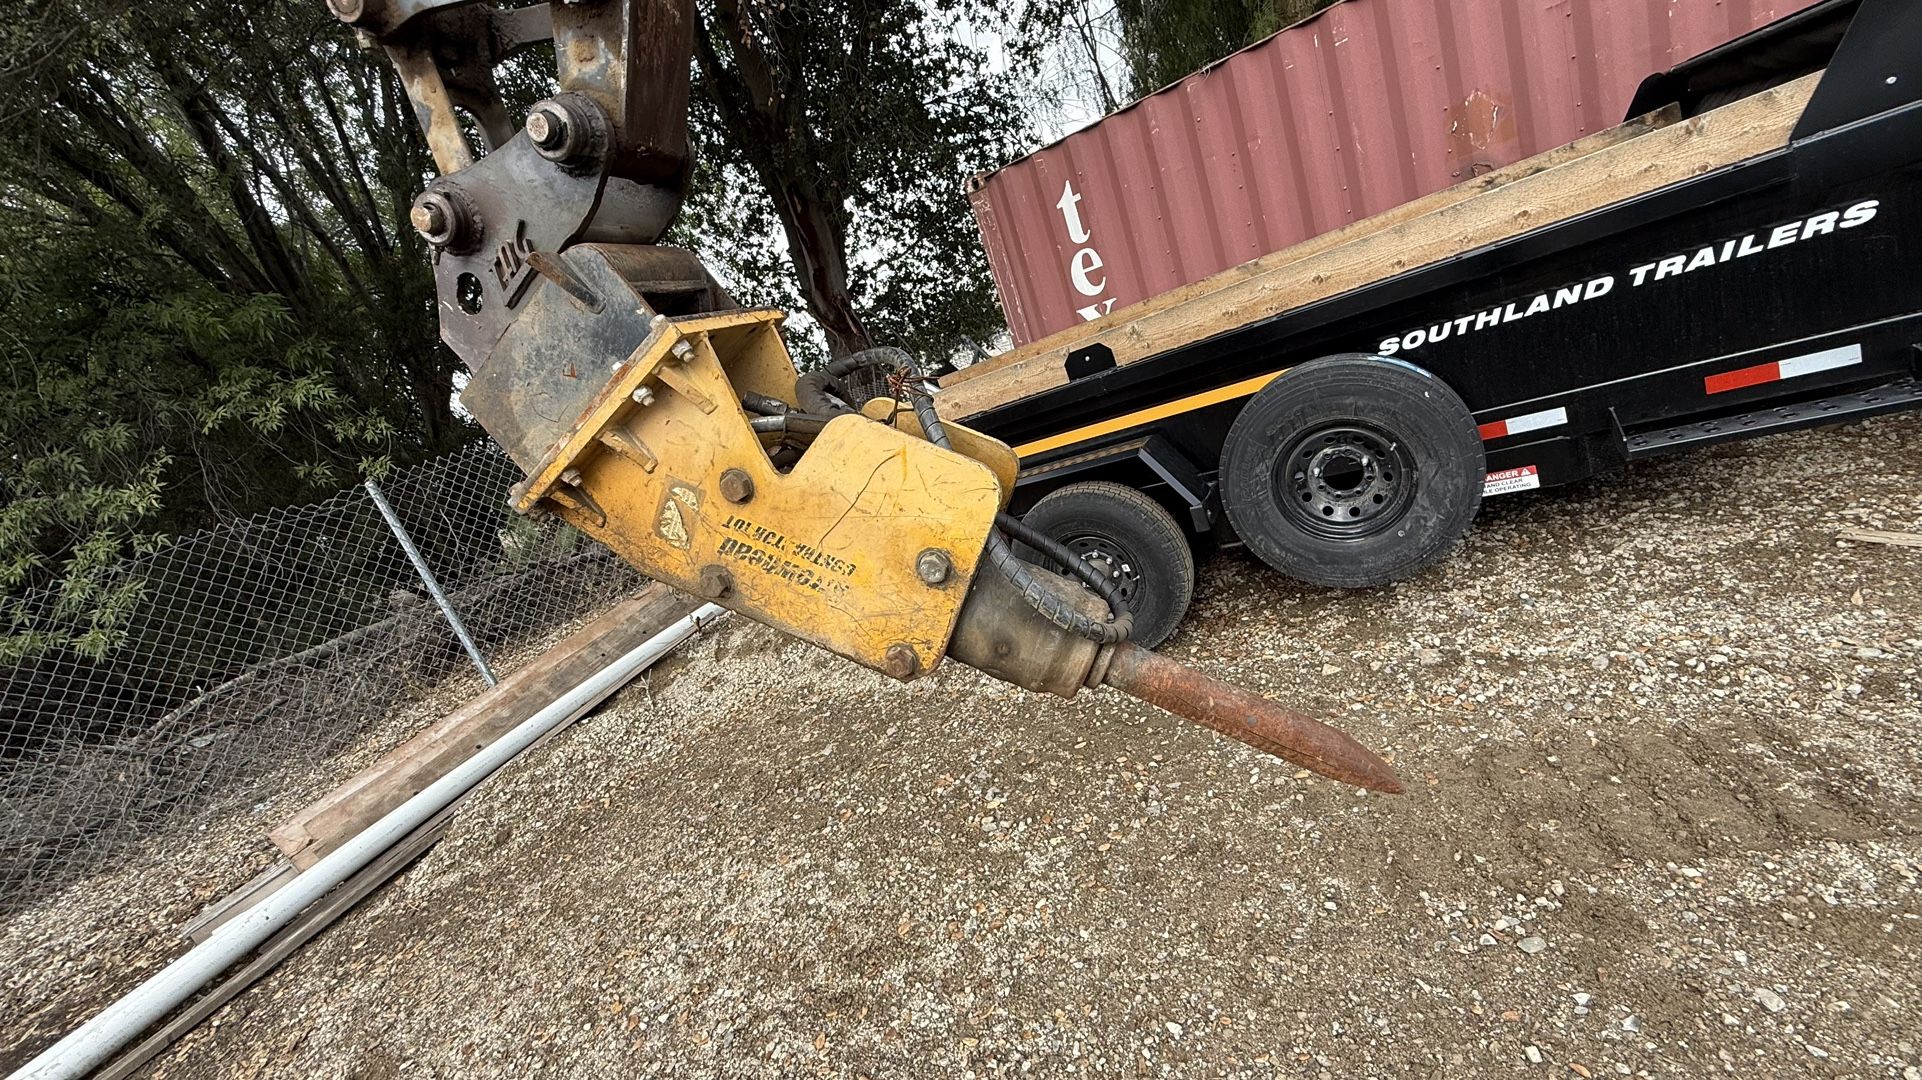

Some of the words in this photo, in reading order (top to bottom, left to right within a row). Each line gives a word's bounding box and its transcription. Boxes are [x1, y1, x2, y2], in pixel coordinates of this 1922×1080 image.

[1377, 276, 1615, 355] SOUTHLAND
[1629, 200, 1880, 287] TRAILERS
[1485, 470, 1519, 481] ANGER
